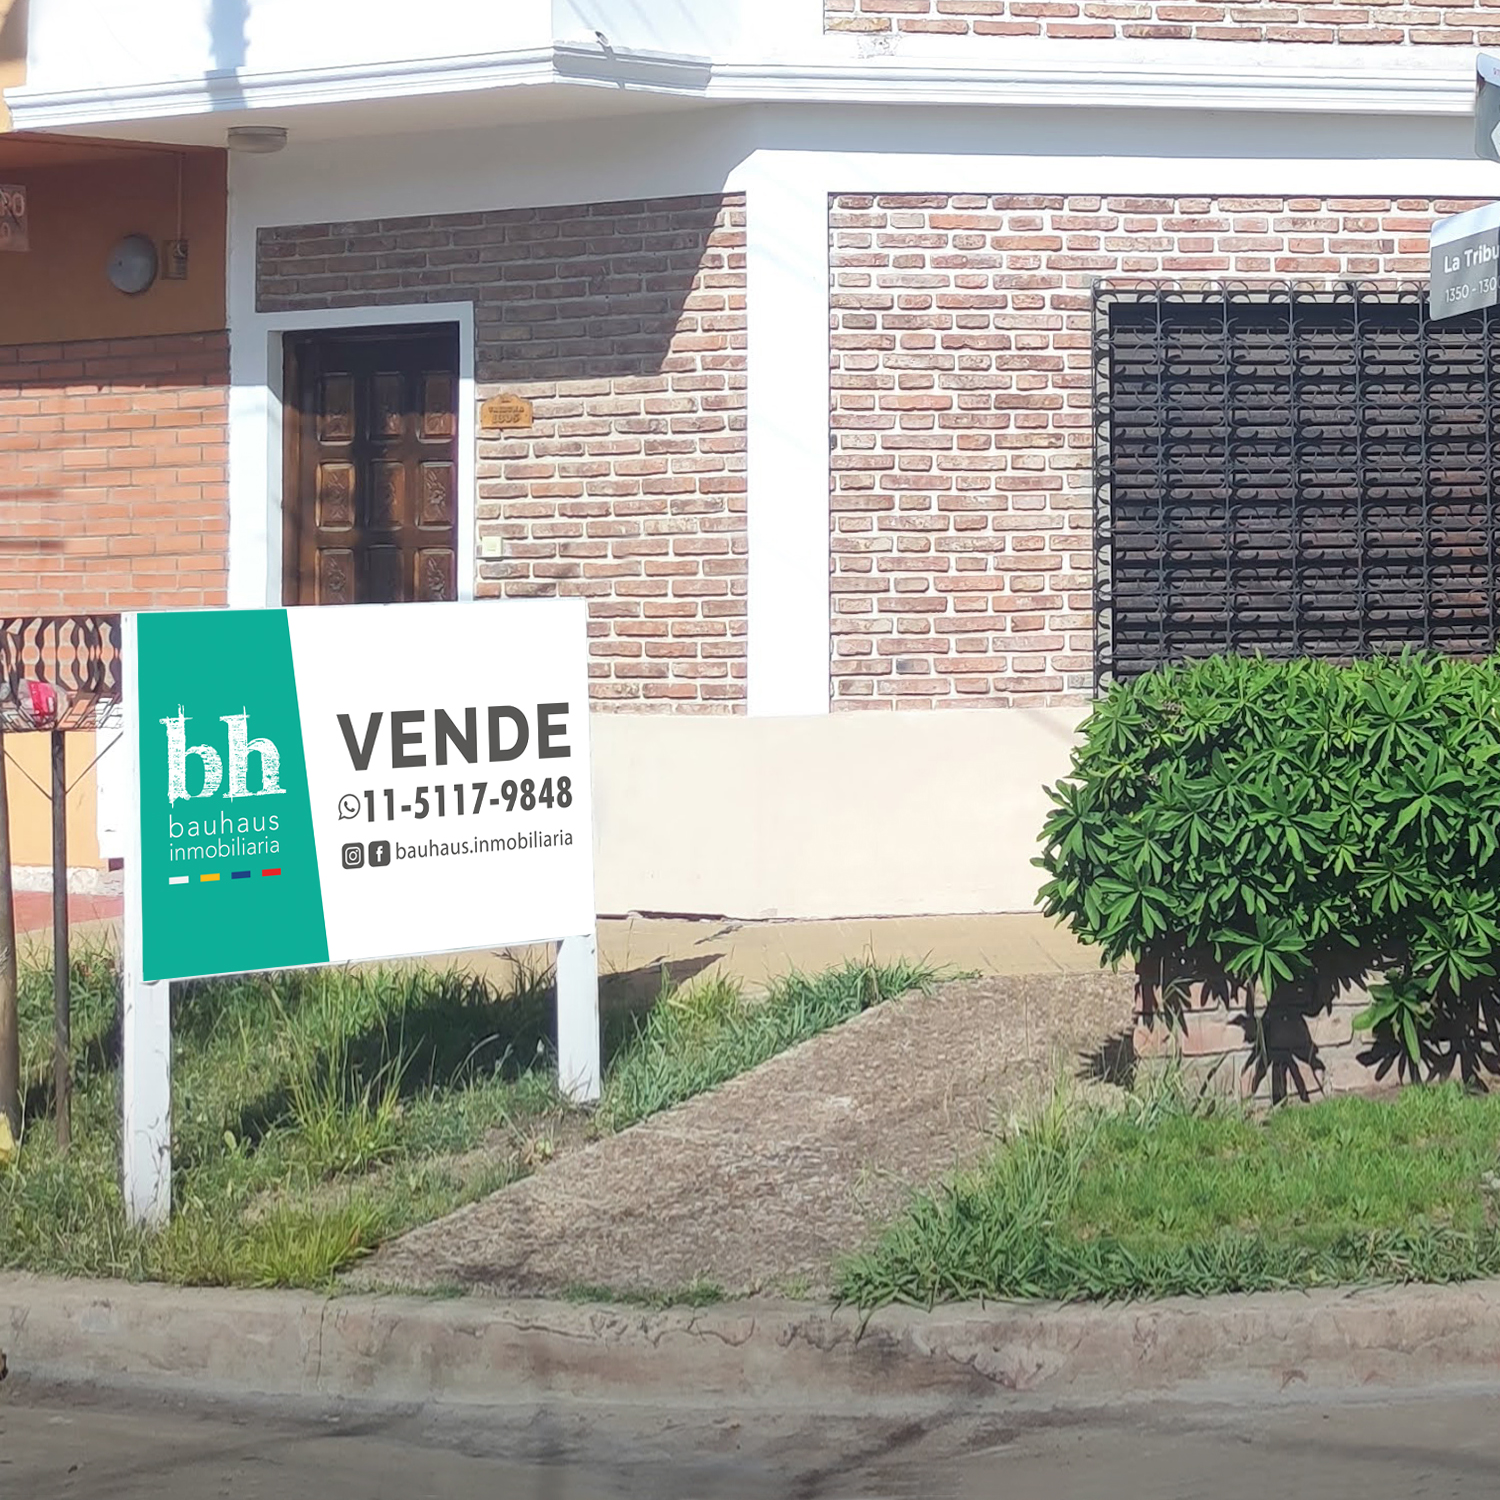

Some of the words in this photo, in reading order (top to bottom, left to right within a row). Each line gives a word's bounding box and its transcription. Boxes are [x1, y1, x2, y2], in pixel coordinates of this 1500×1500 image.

[1444, 256, 1460, 274] La
[1445, 284, 1470, 303] 1350
[336, 702, 572, 771] VENDE
[158, 704, 287, 808] bh
[363, 775, 573, 822] 11-5117-9848
[169, 811, 280, 838] bauhaus
[169, 836, 280, 862] inmobiliaria
[395, 829, 574, 861] bauhaus.inmobiliaria
